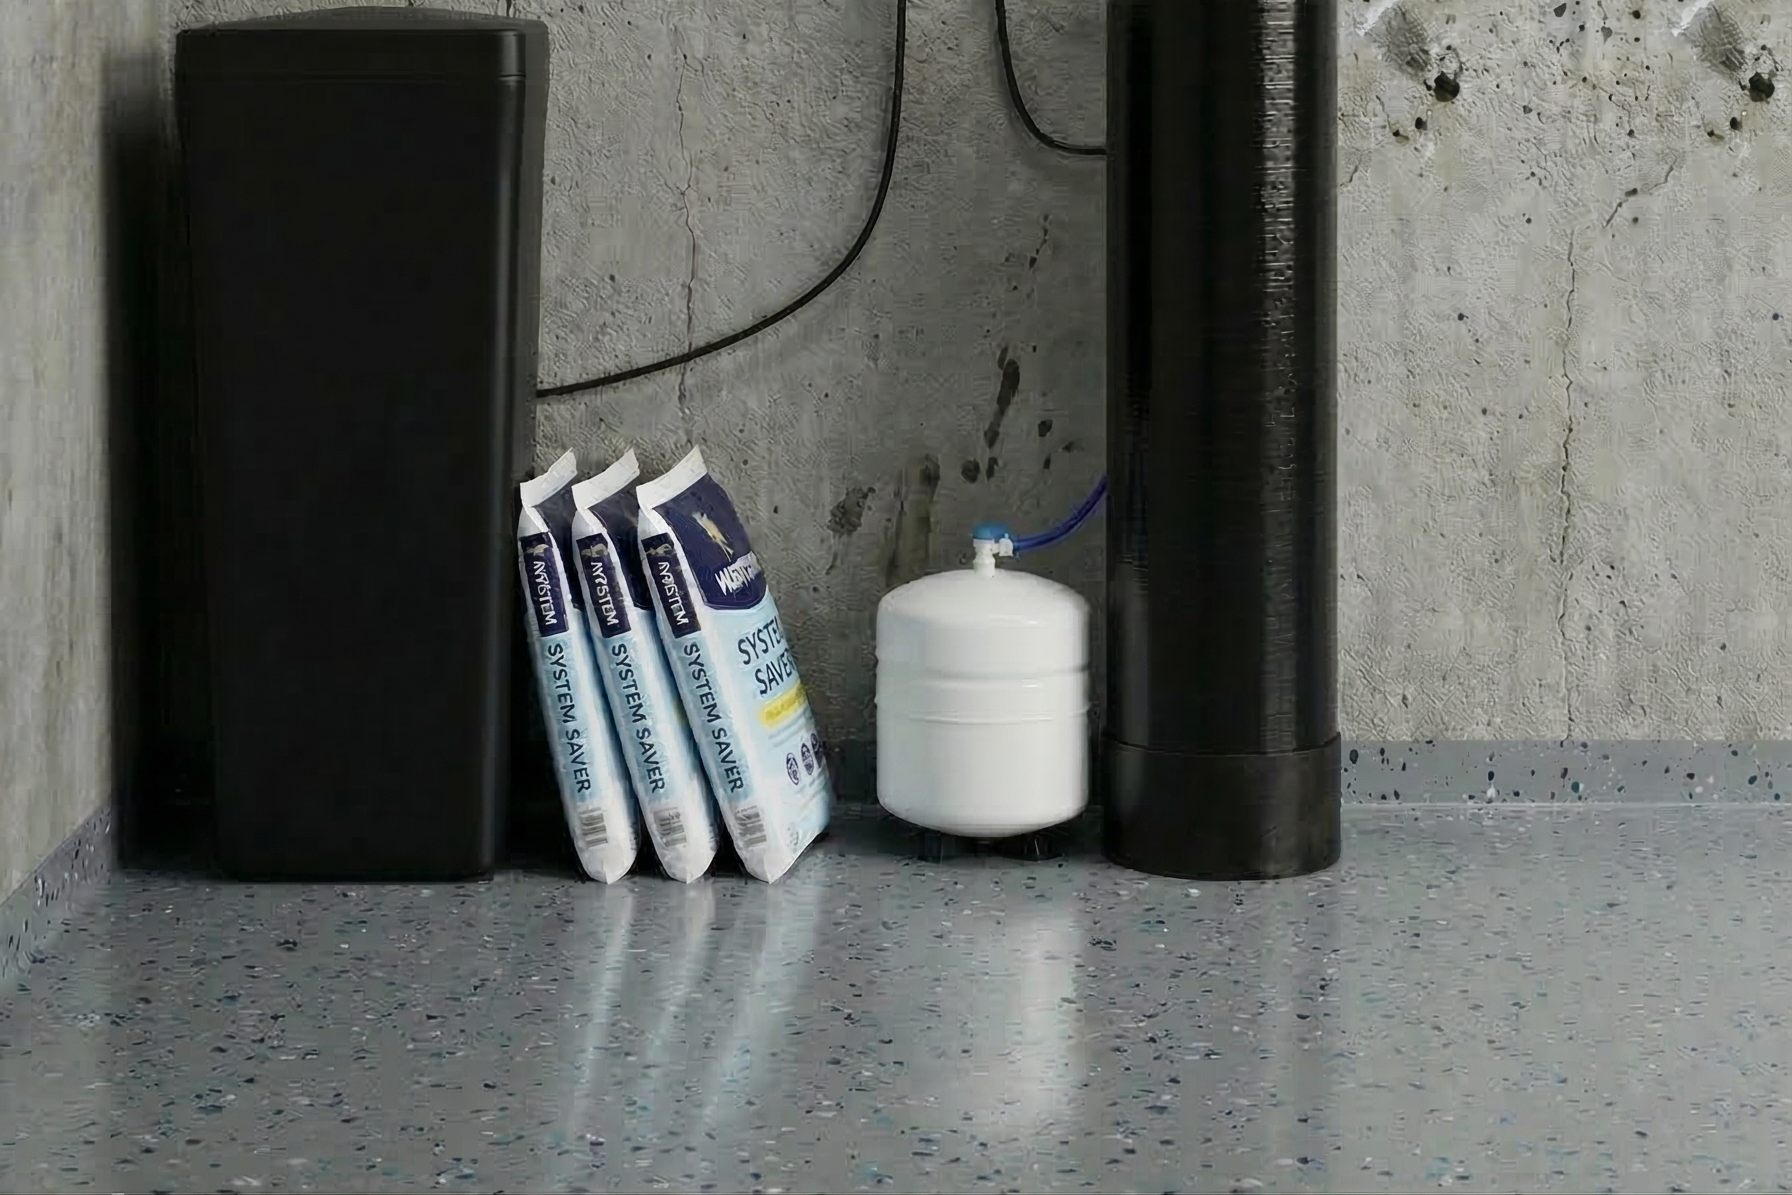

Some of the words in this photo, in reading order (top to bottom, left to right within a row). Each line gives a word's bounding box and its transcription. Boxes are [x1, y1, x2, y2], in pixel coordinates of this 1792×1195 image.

[547, 643, 576, 724] SYSTEM
[565, 728, 592, 793] SAVER
[611, 643, 647, 724] SYSTEM
[636, 727, 666, 793] SAVER
[683, 641, 722, 724] SYSTEM
[712, 727, 744, 793] SAVER
